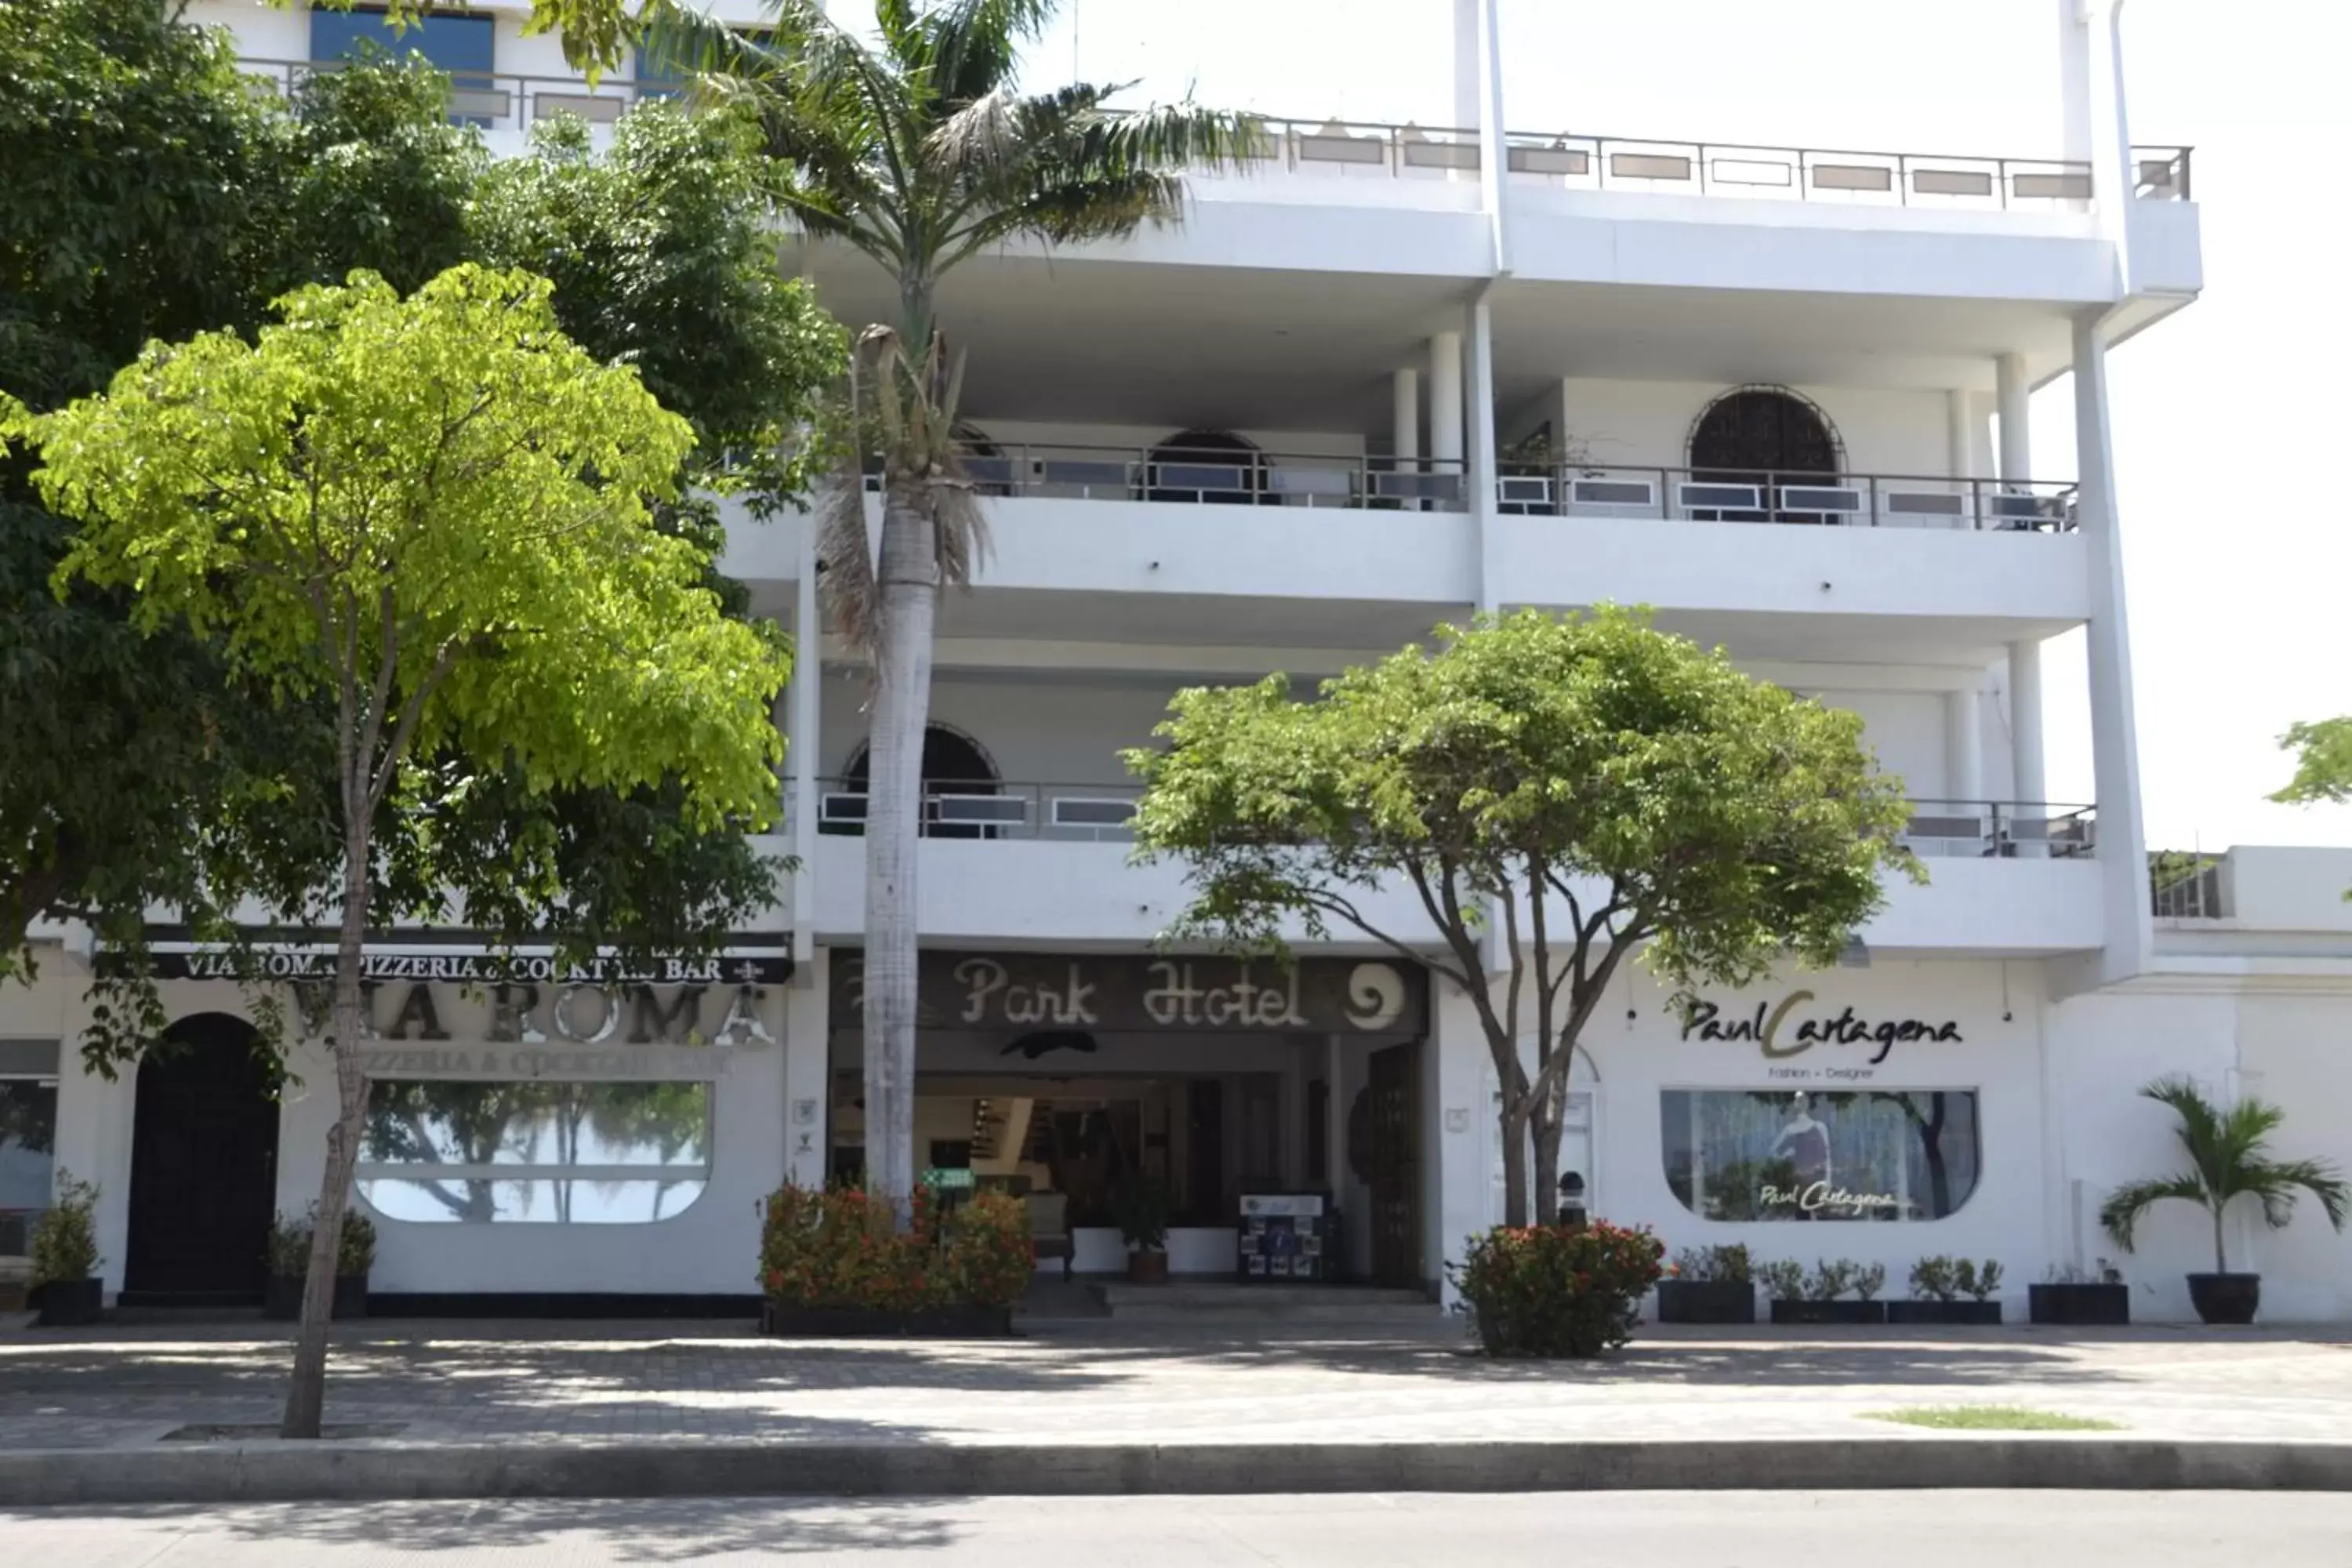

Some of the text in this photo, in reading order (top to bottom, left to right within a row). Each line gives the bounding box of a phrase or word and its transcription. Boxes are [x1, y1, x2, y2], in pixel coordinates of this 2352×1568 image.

[185, 955, 237, 975] VIA
[359, 956, 479, 978] IZZERIA
[666, 958, 723, 979] BAR
[954, 957, 1310, 1028] Park Hotel
[485, 982, 775, 1045] ROMA
[1681, 990, 1963, 1065] Paul Cartagena
[1760, 1181, 1896, 1216] Paul Cartagena
